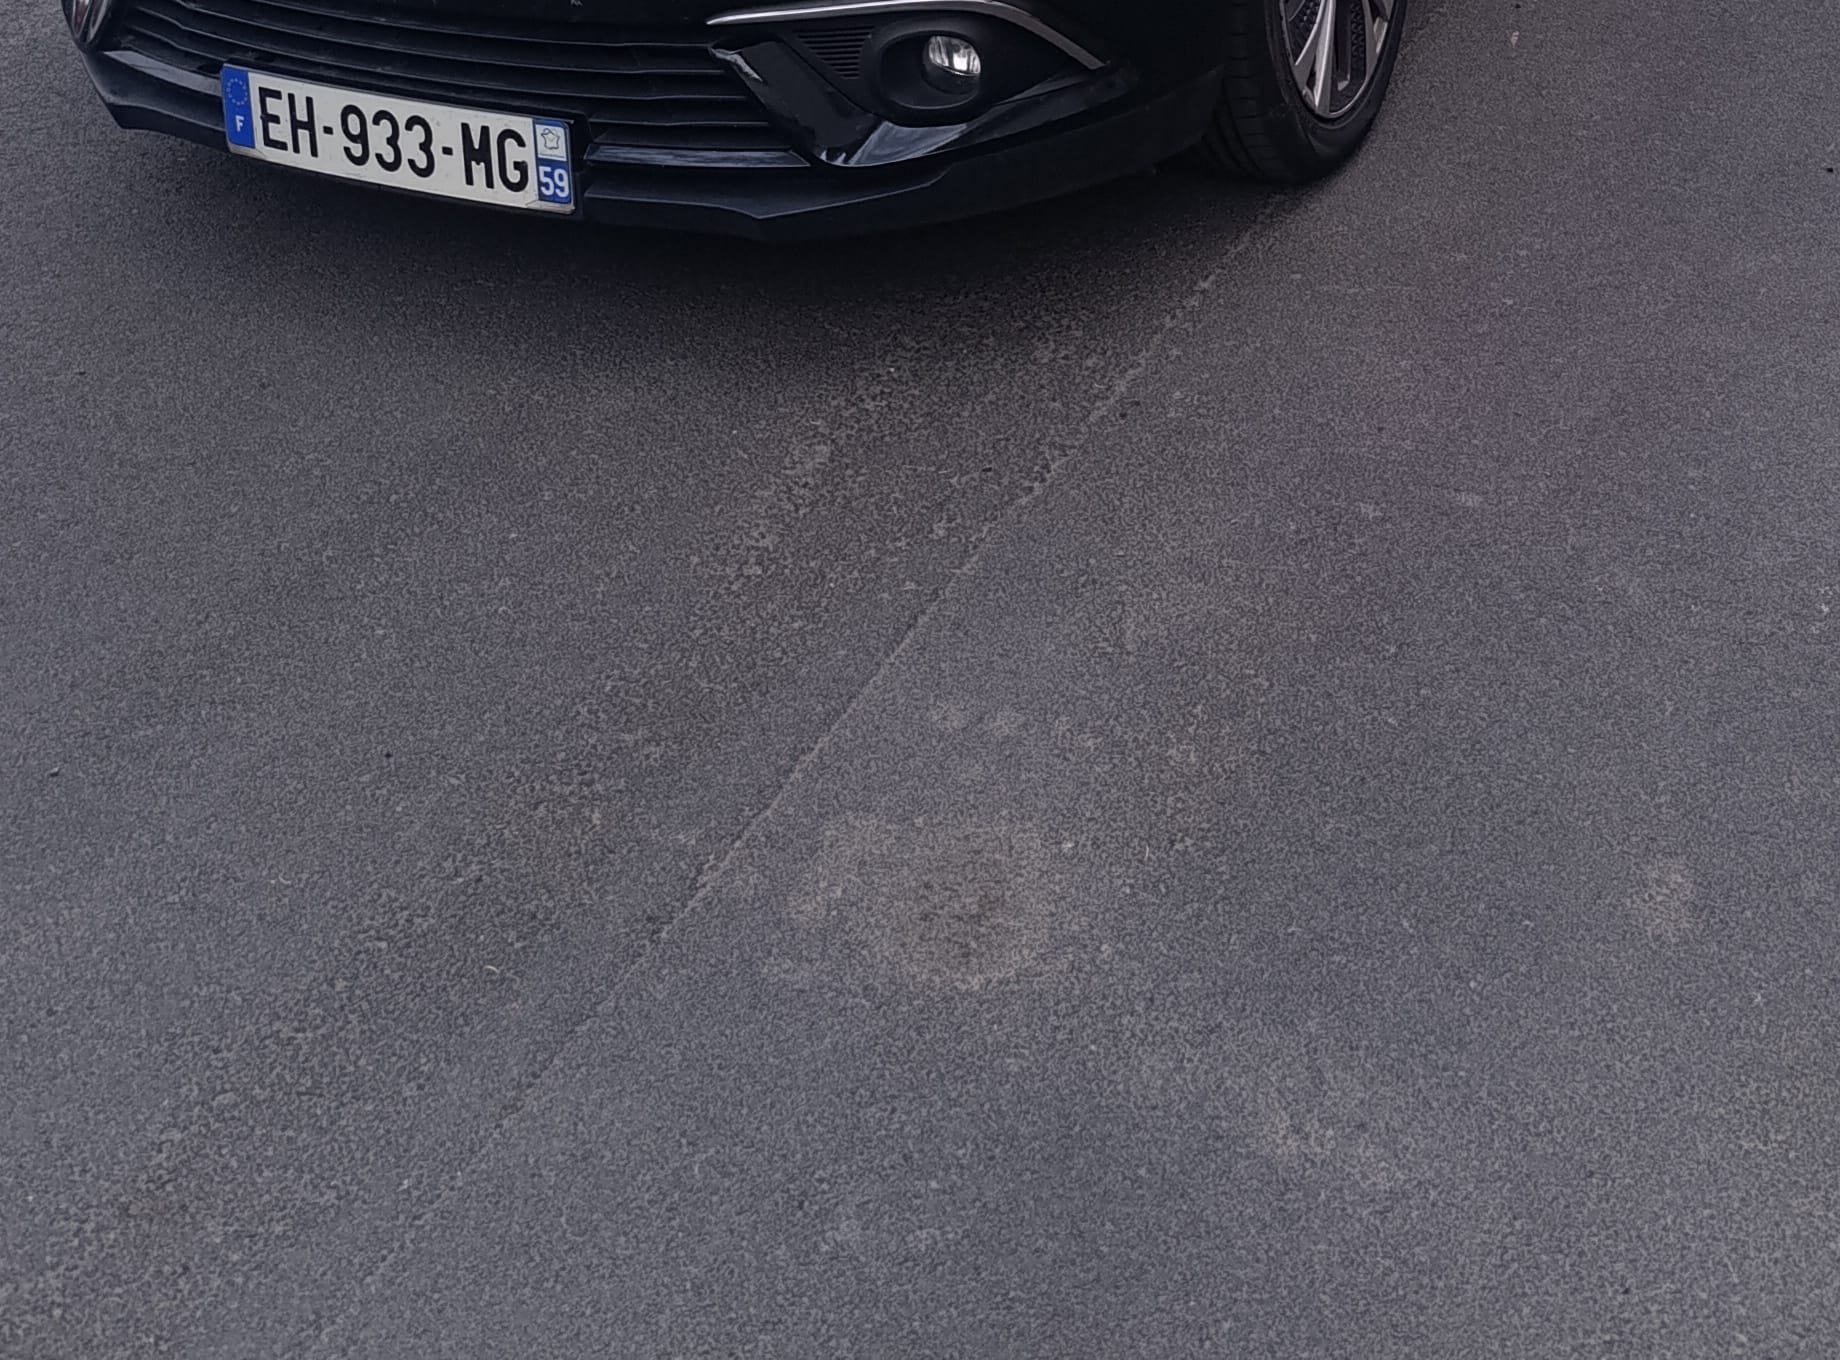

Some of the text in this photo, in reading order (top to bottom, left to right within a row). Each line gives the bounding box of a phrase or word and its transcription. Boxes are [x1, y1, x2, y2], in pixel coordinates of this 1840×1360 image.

[235, 115, 245, 132] F
[258, 86, 529, 193] EH-933-MG
[538, 165, 570, 198] 59
